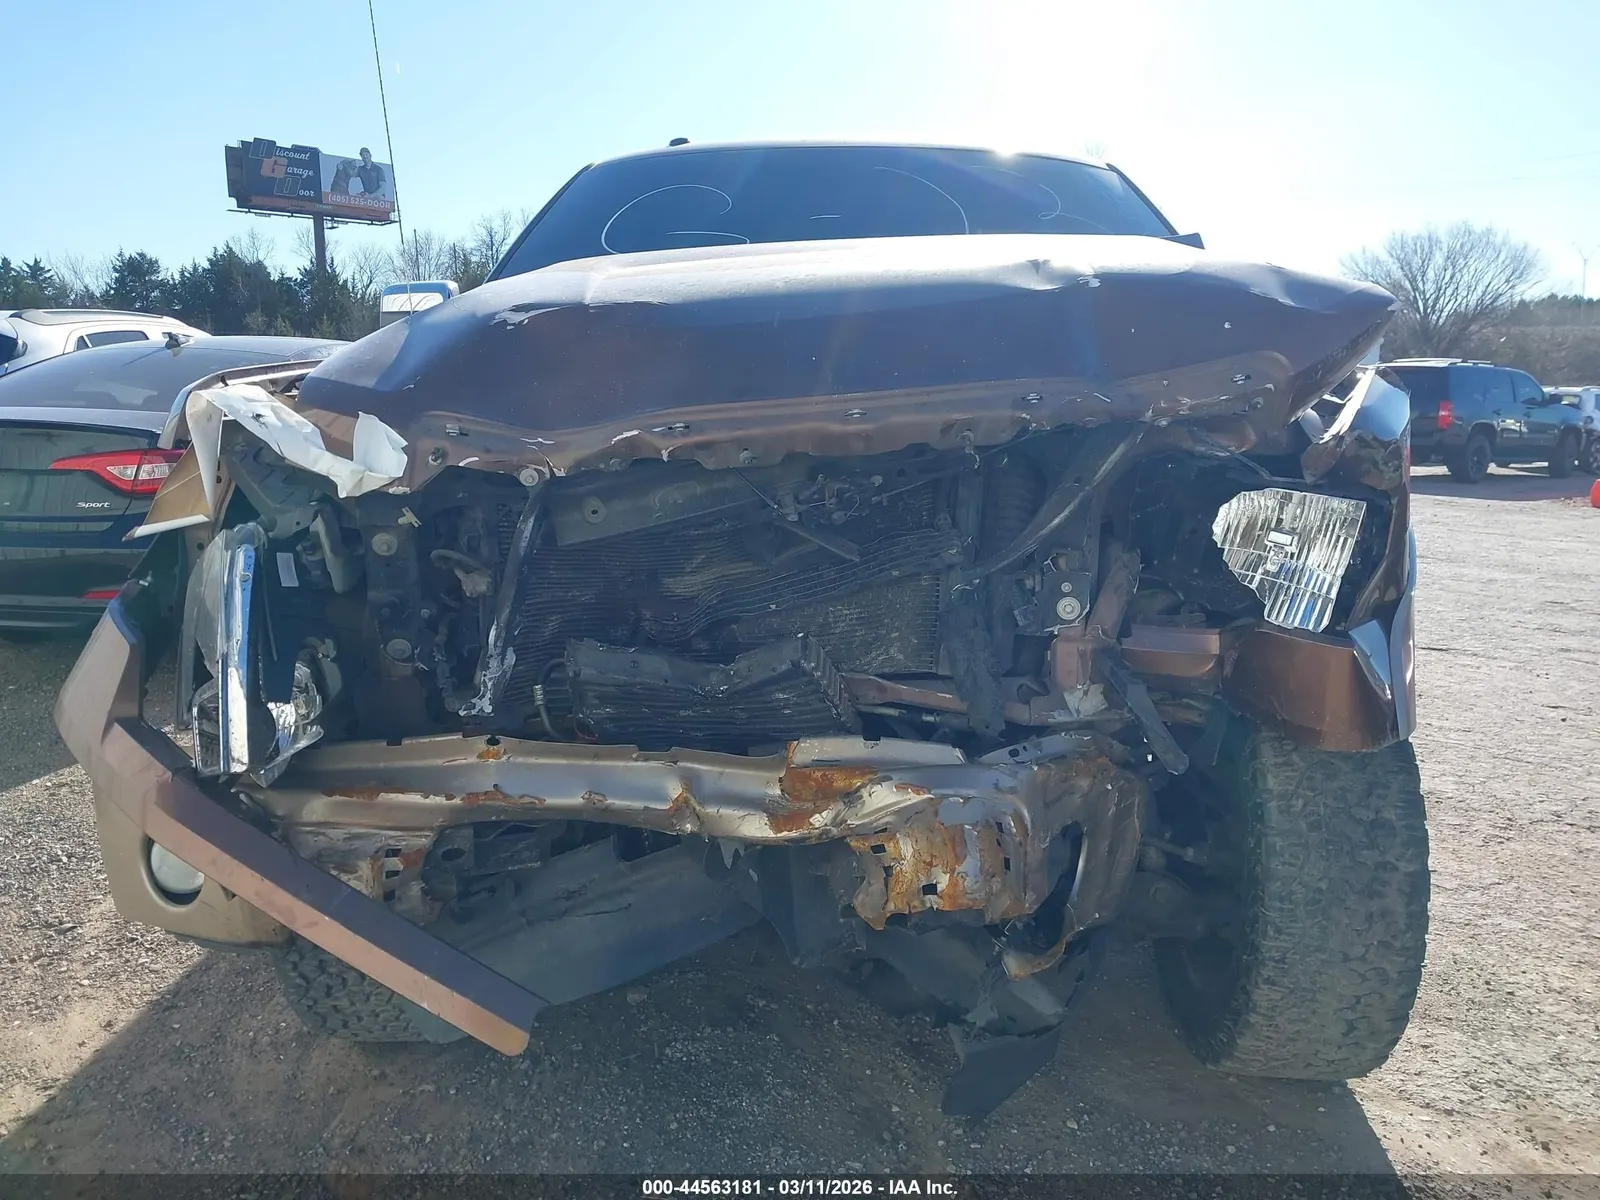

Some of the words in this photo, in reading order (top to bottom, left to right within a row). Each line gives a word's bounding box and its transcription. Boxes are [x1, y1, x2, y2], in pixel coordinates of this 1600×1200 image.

[328, 193, 349, 204] (405)
[350, 196, 391, 209] 525-DOOR
[76, 501, 111, 509] Sport
